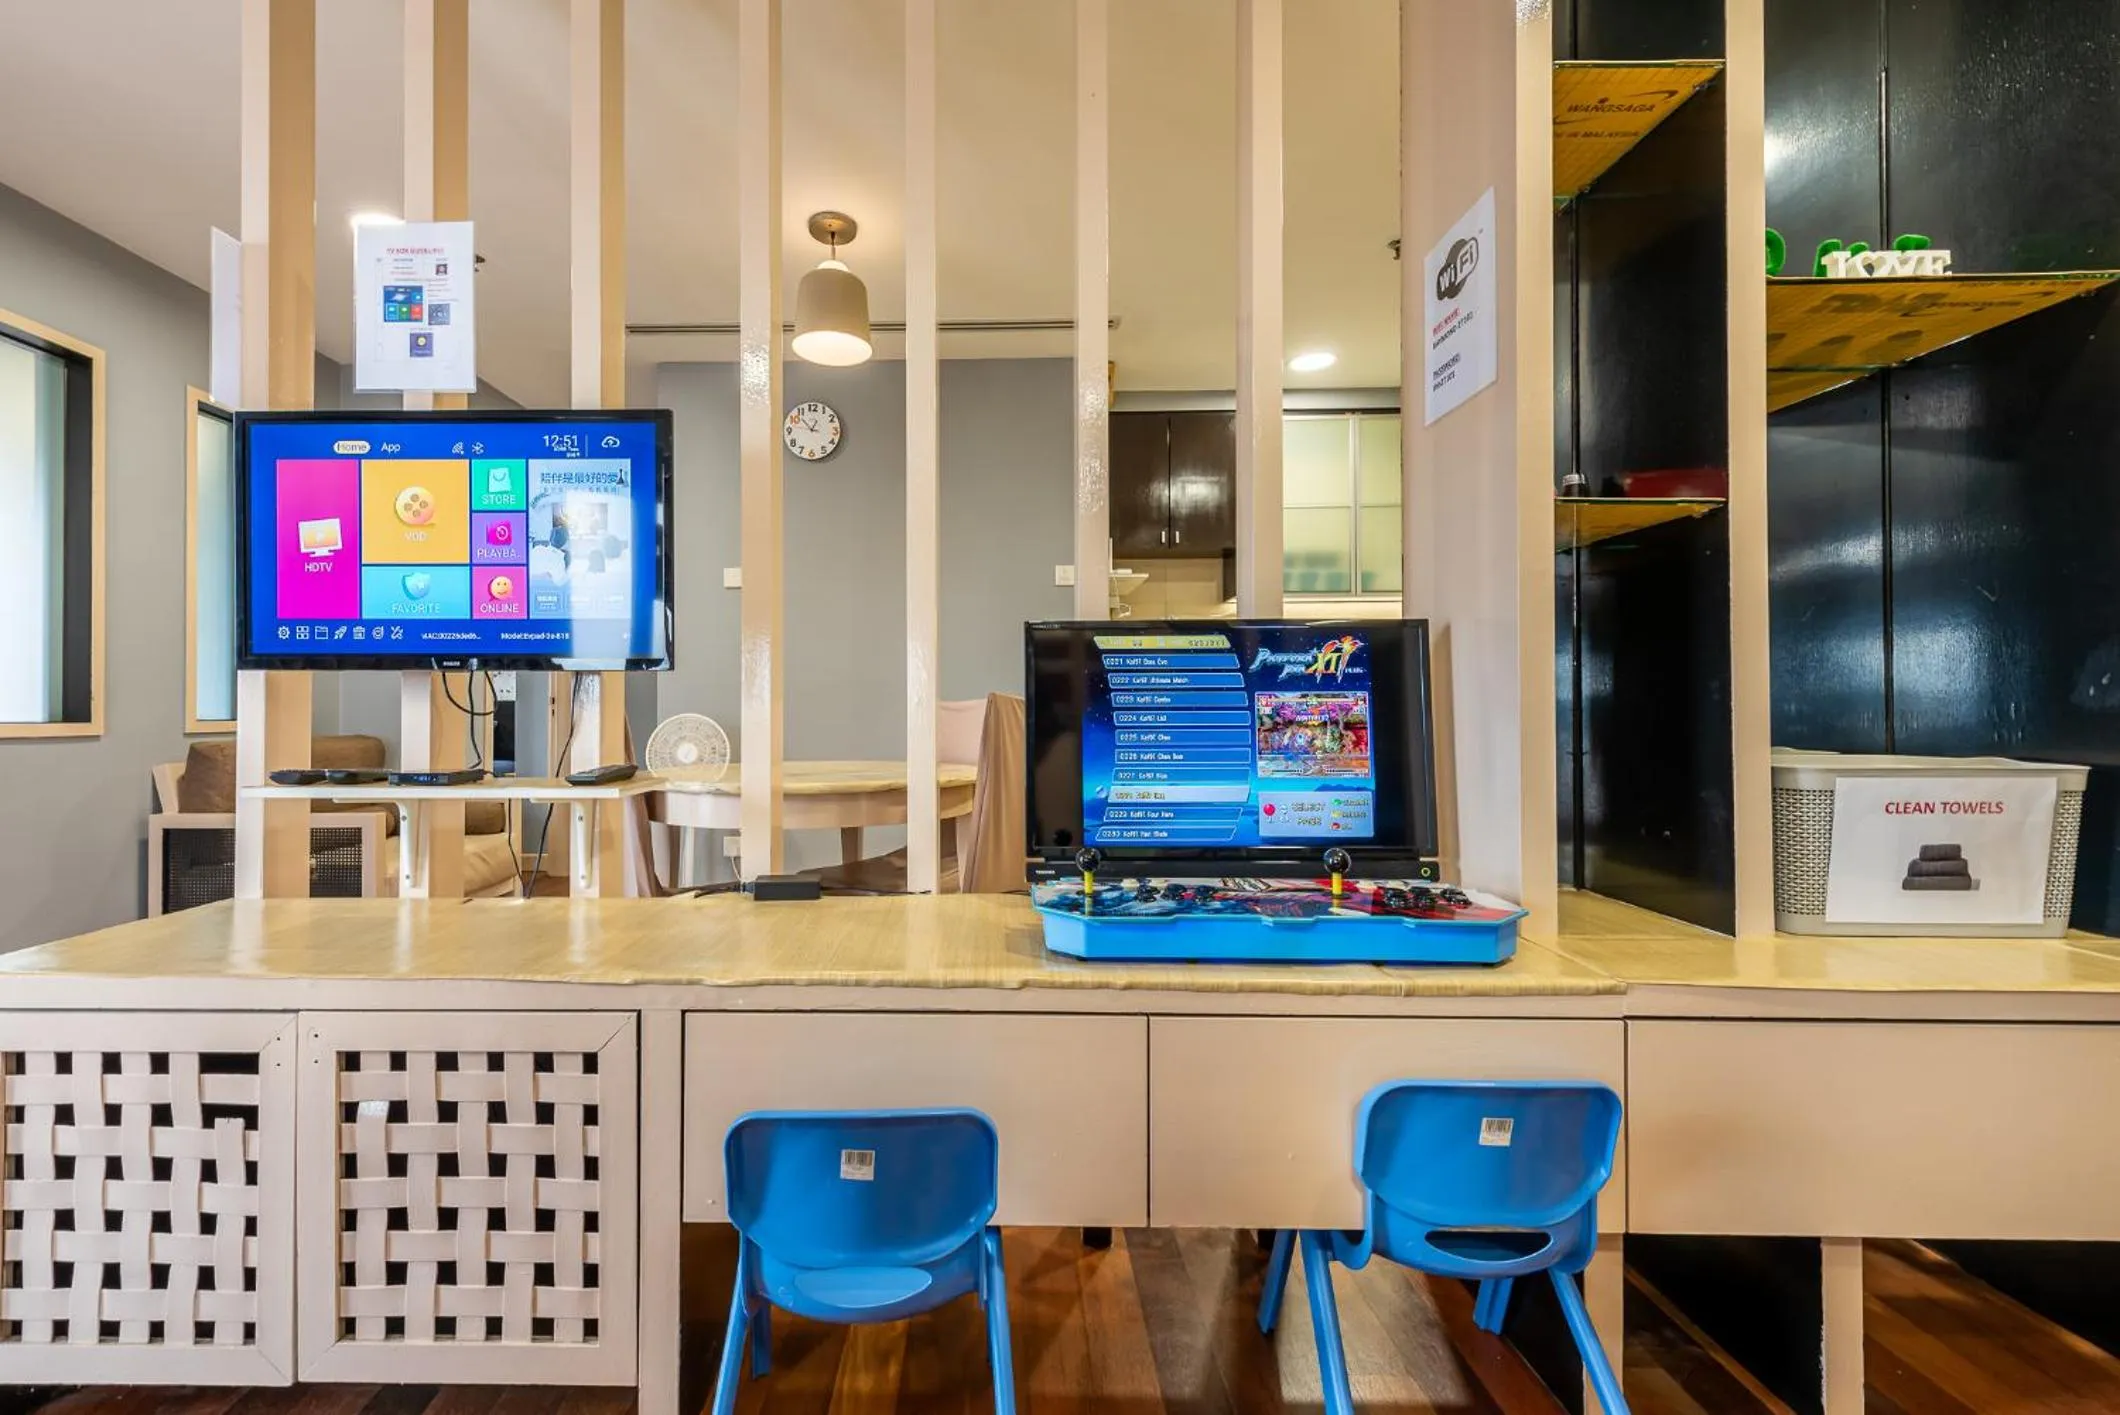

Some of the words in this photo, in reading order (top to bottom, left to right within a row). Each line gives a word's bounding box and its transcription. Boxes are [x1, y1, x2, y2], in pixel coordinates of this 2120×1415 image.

[798, 408, 804, 416] 11
[808, 404, 818, 412] 12
[790, 415, 800, 424] 10
[829, 414, 835, 422] 2
[786, 426, 792, 435] 9
[832, 427, 838, 435] 3
[543, 435, 578, 447] 12:51
[790, 439, 796, 447] 8
[337, 442, 367, 452] Home
[381, 442, 401, 454] App
[808, 449, 815, 457] 6
[482, 495, 516, 505] STORE
[304, 562, 333, 573] HDTV
[392, 603, 441, 614] FAVORITE
[480, 603, 519, 614] ONLINE
[1885, 801, 1935, 815] CLEAN
[1940, 801, 2005, 815] TOWELS
